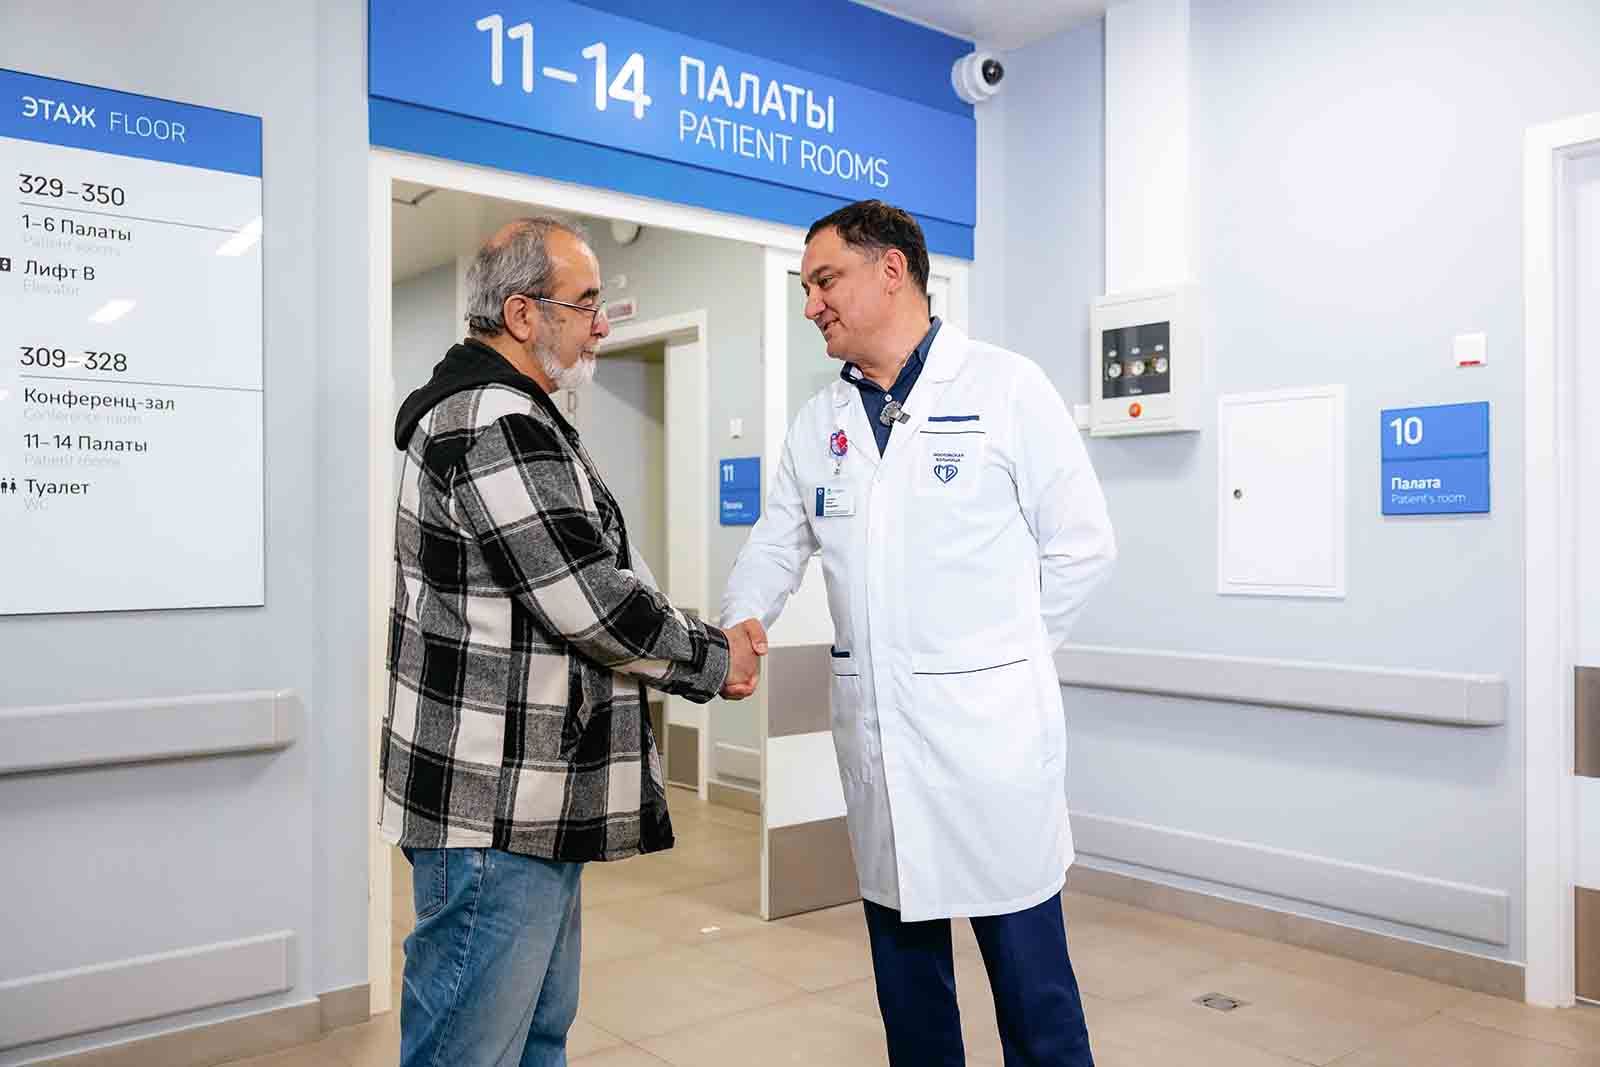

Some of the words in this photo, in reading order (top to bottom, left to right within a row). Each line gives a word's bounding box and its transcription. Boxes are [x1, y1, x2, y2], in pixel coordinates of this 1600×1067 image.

[679, 55, 836, 134] ПАЛАТЫ
[21, 95, 97, 128] ЭТАЖ
[108, 111, 186, 143] FLOOR
[679, 110, 792, 165] PATIENT
[800, 139, 890, 188] ROOMS
[60, 219, 132, 242] Палаты
[23, 259, 78, 282] Лифт
[23, 388, 176, 412] Конференц-зал
[1390, 416, 1424, 446] 10
[77, 435, 148, 452] Палаты
[723, 463, 734, 482] 11
[1391, 477, 1442, 491] Палата
[24, 479, 90, 497] Туалет
[1437, 493, 1467, 504] room
